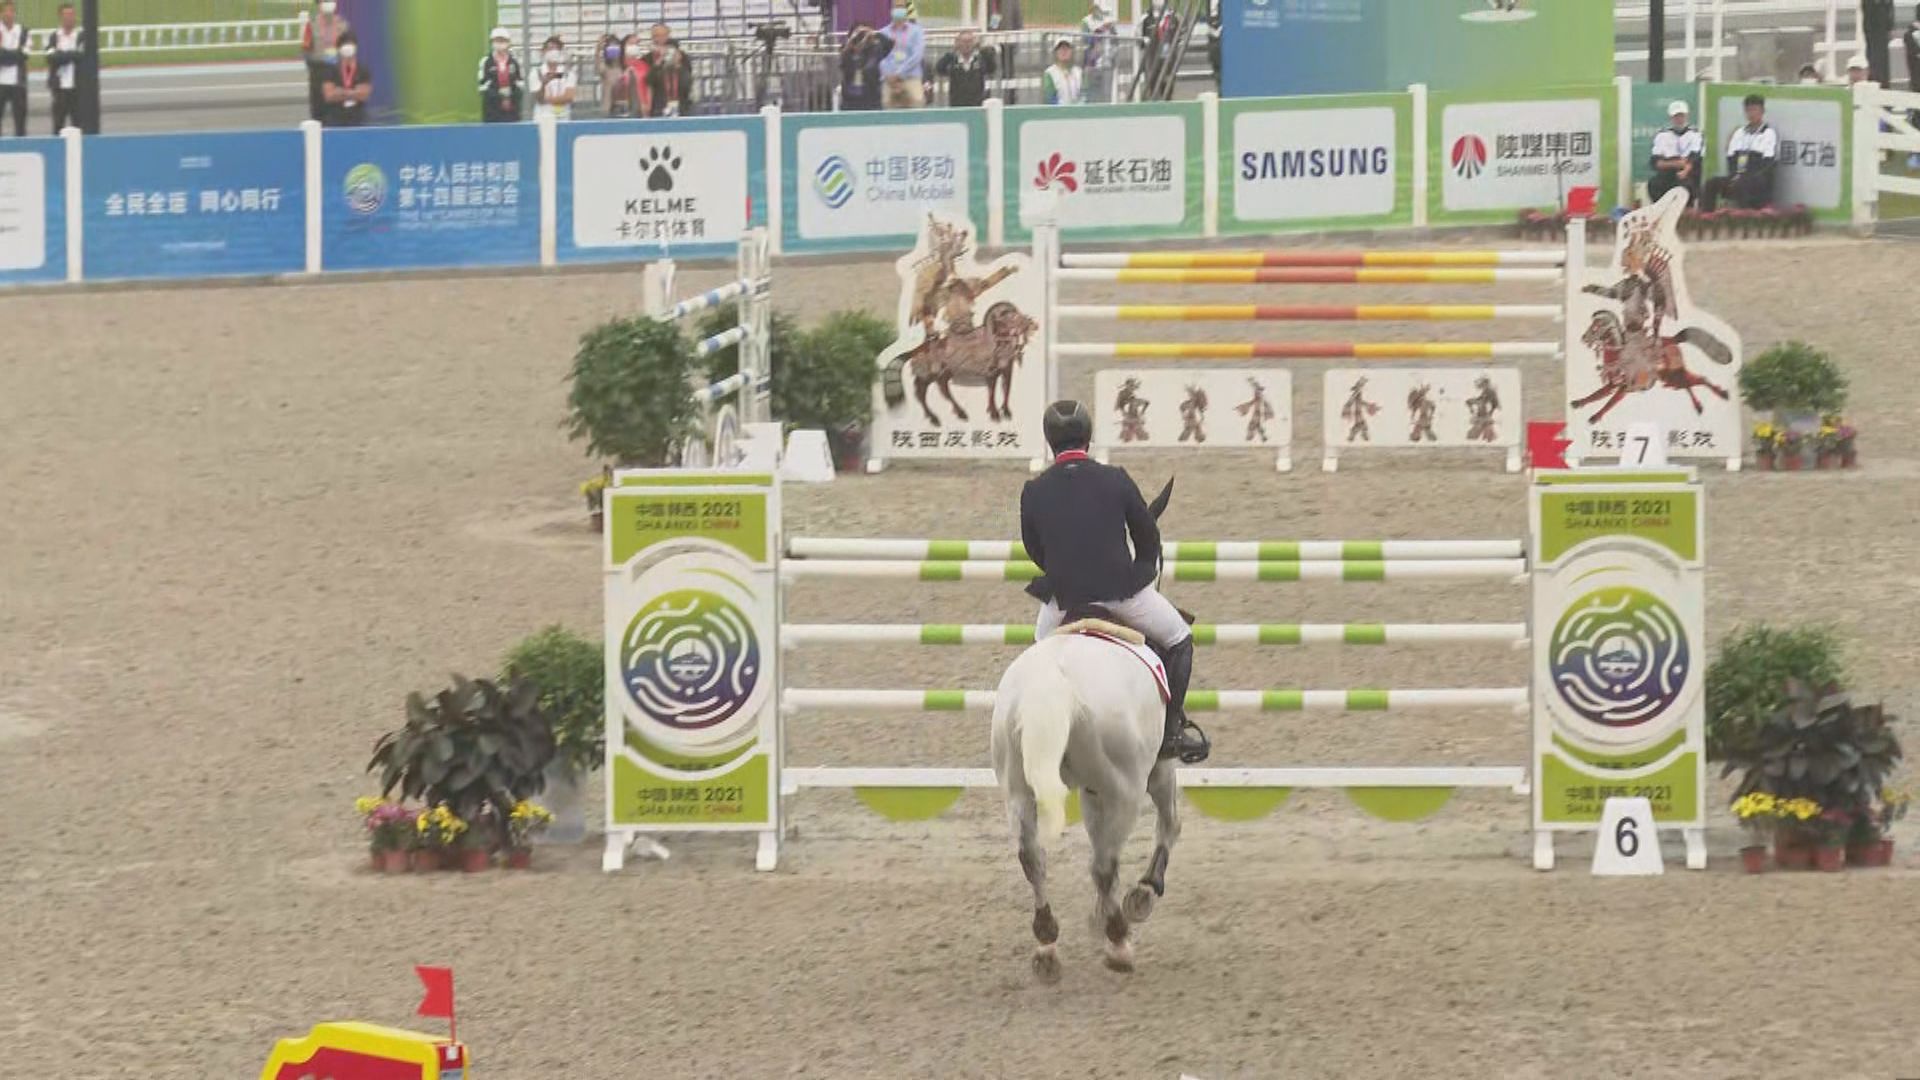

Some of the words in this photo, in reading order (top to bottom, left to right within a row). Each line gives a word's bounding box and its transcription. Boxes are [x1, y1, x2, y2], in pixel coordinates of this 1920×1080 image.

[1496, 131, 1593, 159] 陕煤集团
[400, 160, 520, 185] 中华人民共和国
[866, 155, 955, 182] 中国移动
[1084, 157, 1172, 185] 延长石油
[1242, 146, 1388, 181] SAMSUNG
[104, 191, 188, 216] 全民全运
[200, 187, 281, 213] 同心同行
[400, 185, 519, 208] 第十四届运动会
[866, 186, 905, 201] China
[909, 184, 955, 200] Mobile
[625, 197, 697, 215] KELME
[891, 429, 1021, 448] 陕西皮影戏
[1591, 428, 1716, 449] 陕影戏
[1633, 435, 1650, 465] 7
[702, 502, 741, 517] 2021
[1631, 499, 1671, 515] 2021
[704, 786, 744, 802] 2021
[1615, 816, 1639, 858] 6
